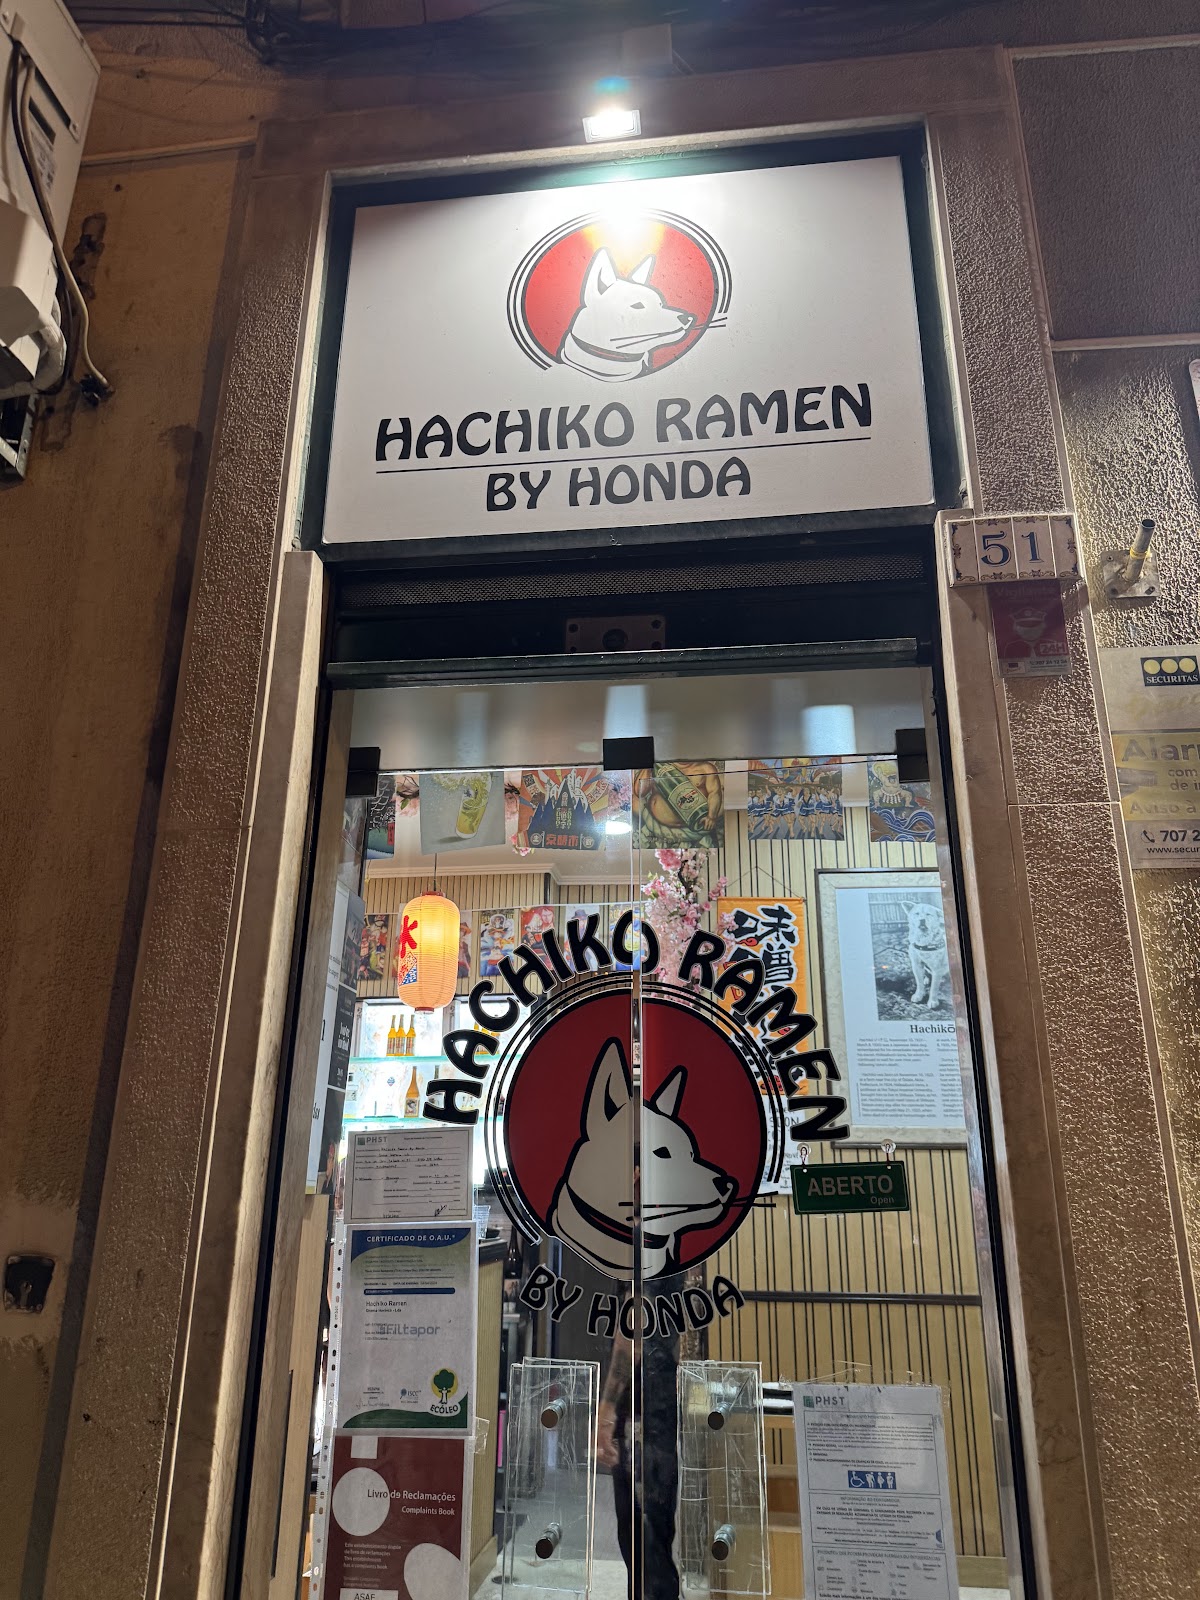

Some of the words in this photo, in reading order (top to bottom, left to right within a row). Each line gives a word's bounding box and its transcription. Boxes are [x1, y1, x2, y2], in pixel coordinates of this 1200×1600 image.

[376, 402, 635, 461] HACHIKO
[655, 382, 872, 444] RAMEN
[486, 469, 551, 512] BY
[569, 457, 751, 508] HONDA
[980, 531, 1041, 567] 51
[1146, 674, 1199, 684] SECURITAS
[1170, 779, 1189, 791] de
[1129, 802, 1180, 815] Aviso
[1160, 830, 1188, 842] 707
[422, 909, 660, 1126] HACHIKO
[678, 931, 851, 1143] RAMEN
[366, 1136, 388, 1144] PHST
[807, 1174, 893, 1197] ABERTO
[870, 1196, 895, 1205] Open
[366, 1235, 415, 1243] CERTIFICADO
[519, 1263, 583, 1322] BY
[586, 1275, 745, 1341] HONDA
[815, 1396, 845, 1406] PHST
[430, 1404, 458, 1414] ECÓLEO
[367, 1489, 388, 1499] Livro
[390, 1490, 400, 1499] de
[402, 1490, 456, 1503] Reclamações
[401, 1506, 437, 1515] Complaints
